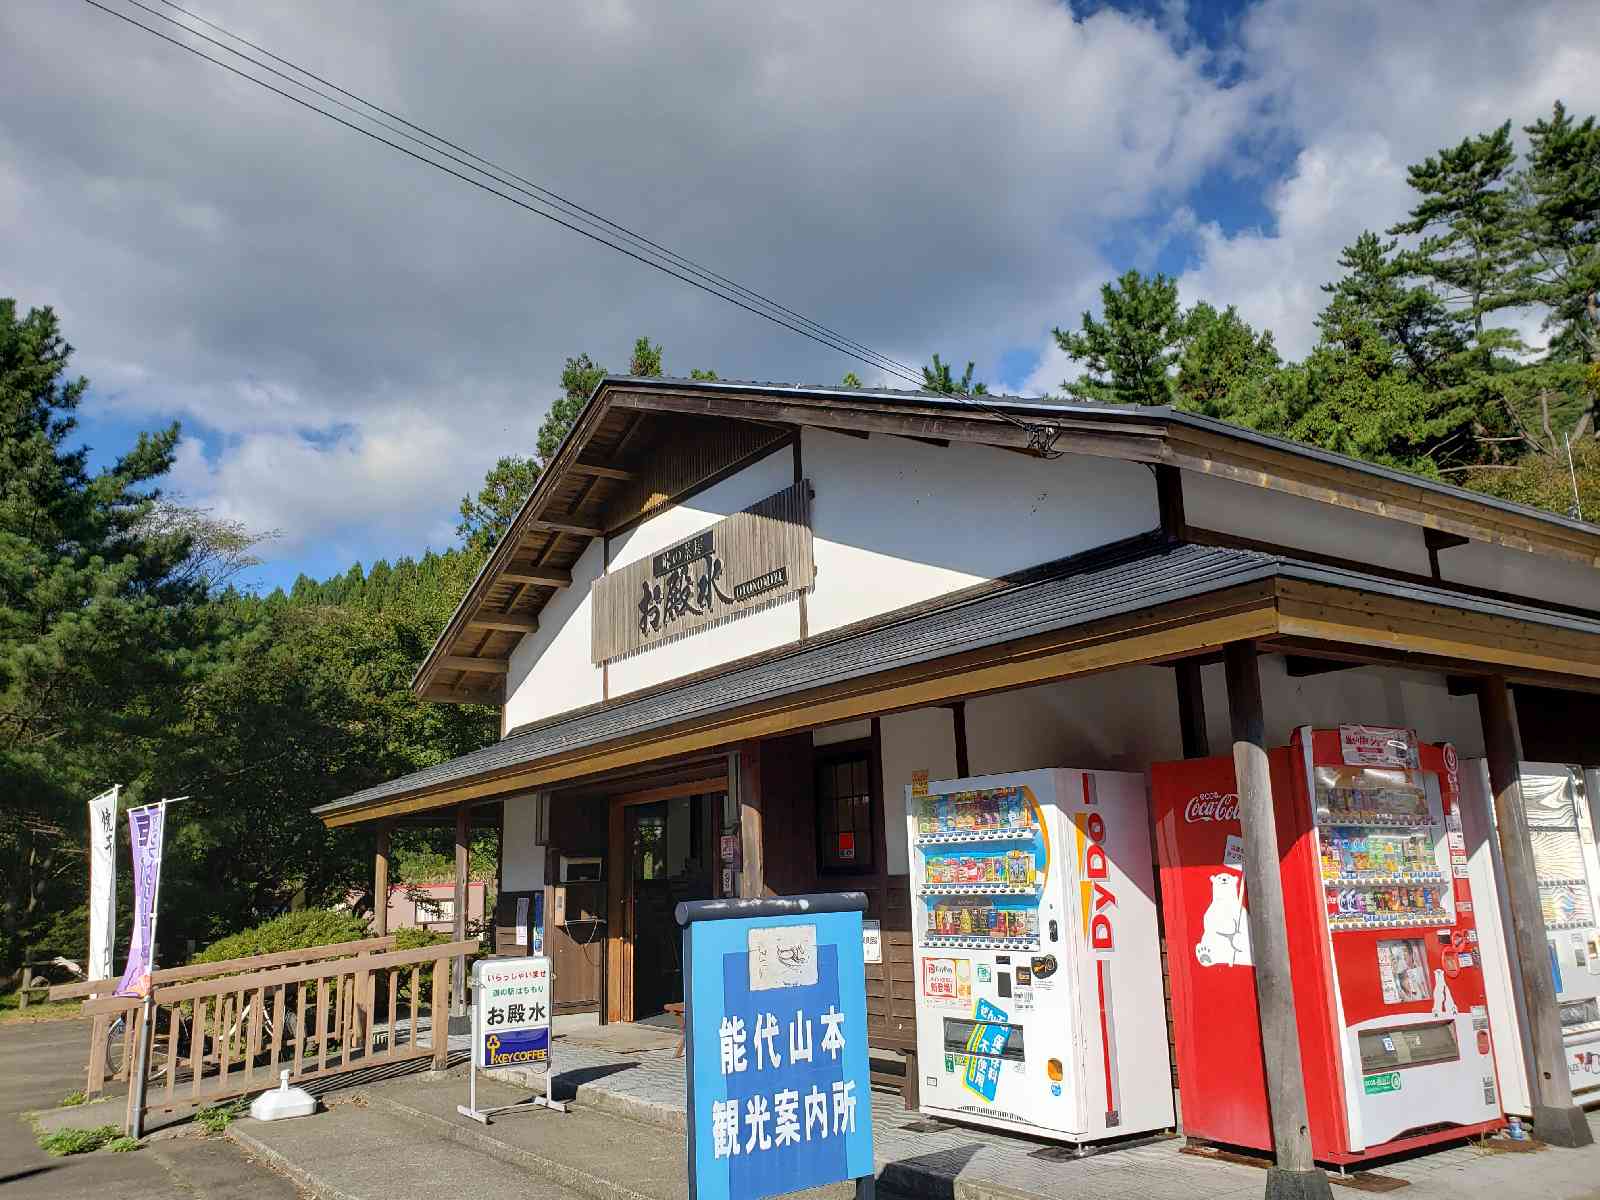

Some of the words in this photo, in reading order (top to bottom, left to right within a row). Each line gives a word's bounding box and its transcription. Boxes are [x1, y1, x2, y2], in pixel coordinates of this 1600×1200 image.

[638, 554, 735, 637] お殿水
[1184, 793, 1240, 823] Coca-Col
[487, 970, 547, 982] いらっしゃいませ
[486, 1001, 547, 1026] お殿水
[718, 1004, 846, 1075] 能代山本
[712, 1080, 857, 1160] 観光案内所
